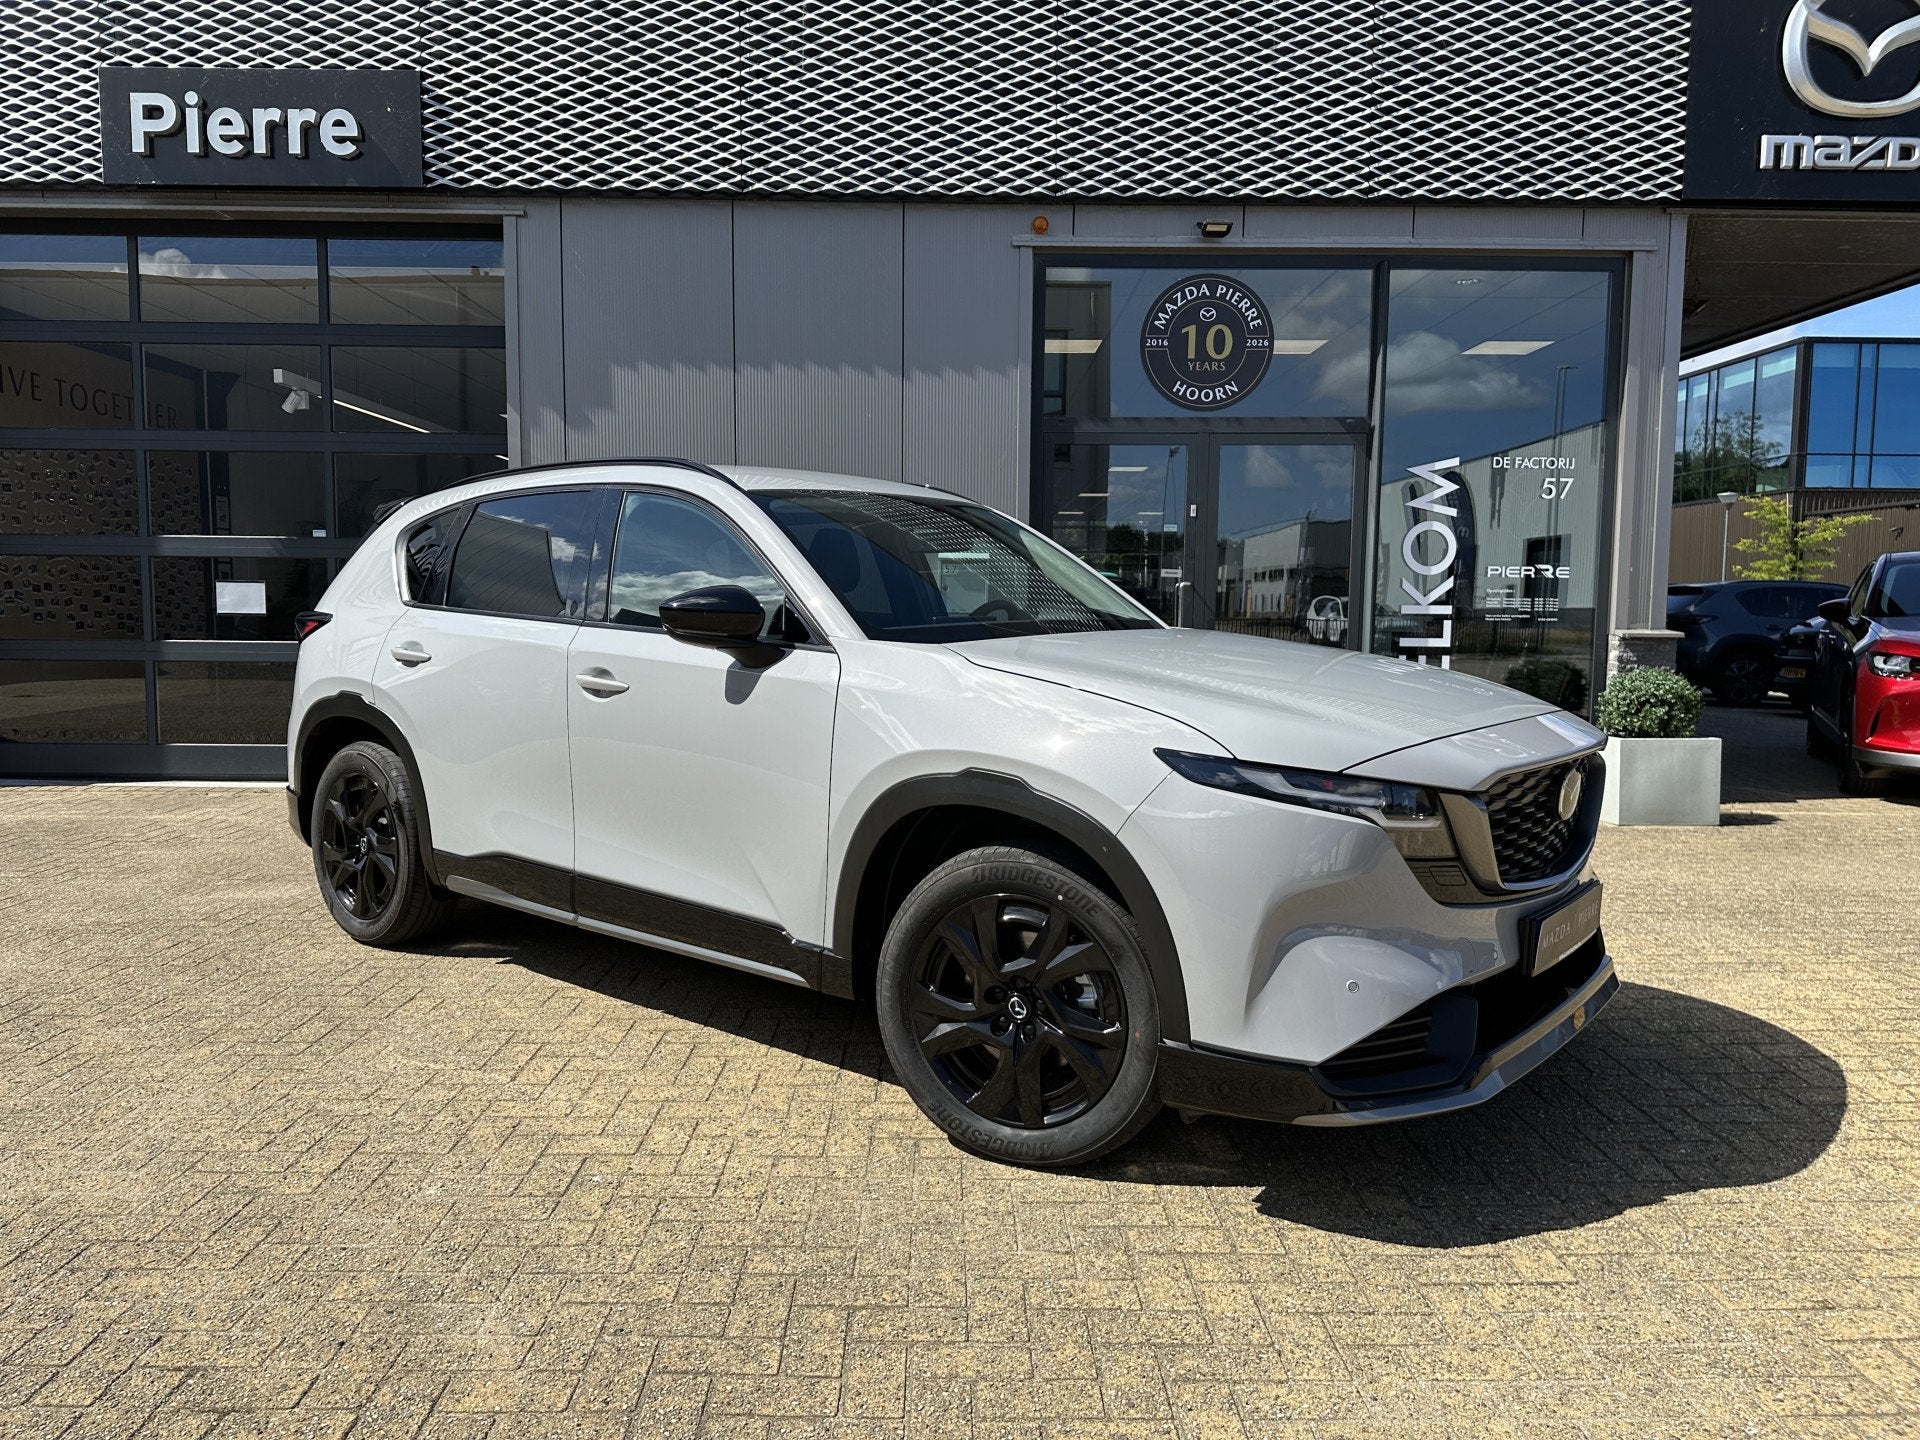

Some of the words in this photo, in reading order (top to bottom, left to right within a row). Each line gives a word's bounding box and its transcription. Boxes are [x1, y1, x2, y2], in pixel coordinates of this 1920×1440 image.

[130, 90, 361, 157] Pierre
[1154, 283, 1210, 330] MAZDA
[1216, 284, 1263, 330] PIERRE
[1146, 338, 1169, 347] 2016
[1181, 324, 1234, 360] 10
[1246, 339, 1269, 347] 2026
[1188, 361, 1226, 371] YEARS
[0, 364, 42, 402] IVE
[53, 378, 179, 430] TOGETER
[1172, 380, 1239, 402] HOORN
[1493, 457, 1511, 469] DE
[1515, 457, 1576, 470] FACTORIJ
[1541, 478, 1575, 500] 57
[1487, 564, 1570, 579] PIERRE
[971, 865, 1100, 918] BRIDGESTONE
[1541, 922, 1571, 948] MAZDA
[1578, 900, 1599, 925] PIERRE
